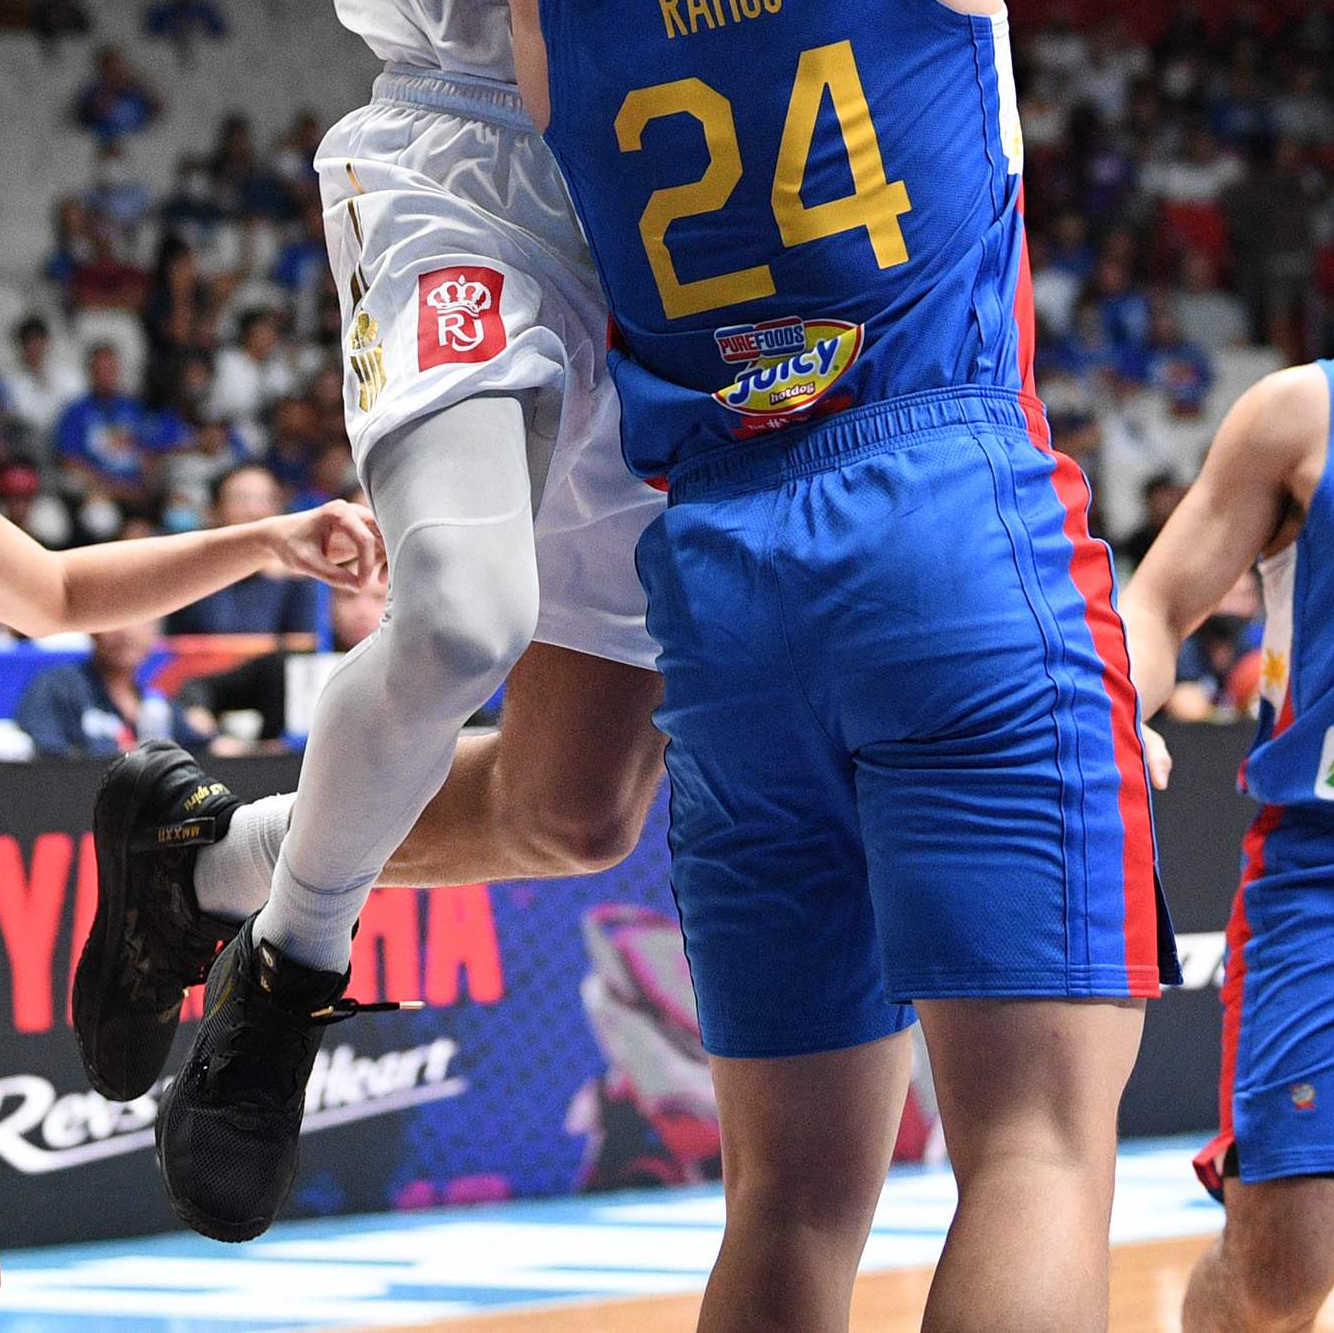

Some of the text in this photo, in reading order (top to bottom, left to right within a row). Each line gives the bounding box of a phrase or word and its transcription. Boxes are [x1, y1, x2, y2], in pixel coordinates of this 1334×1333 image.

[613, 39, 912, 321] 24
[718, 325, 805, 354] PUREFOODS
[770, 382, 815, 404] hotdog
